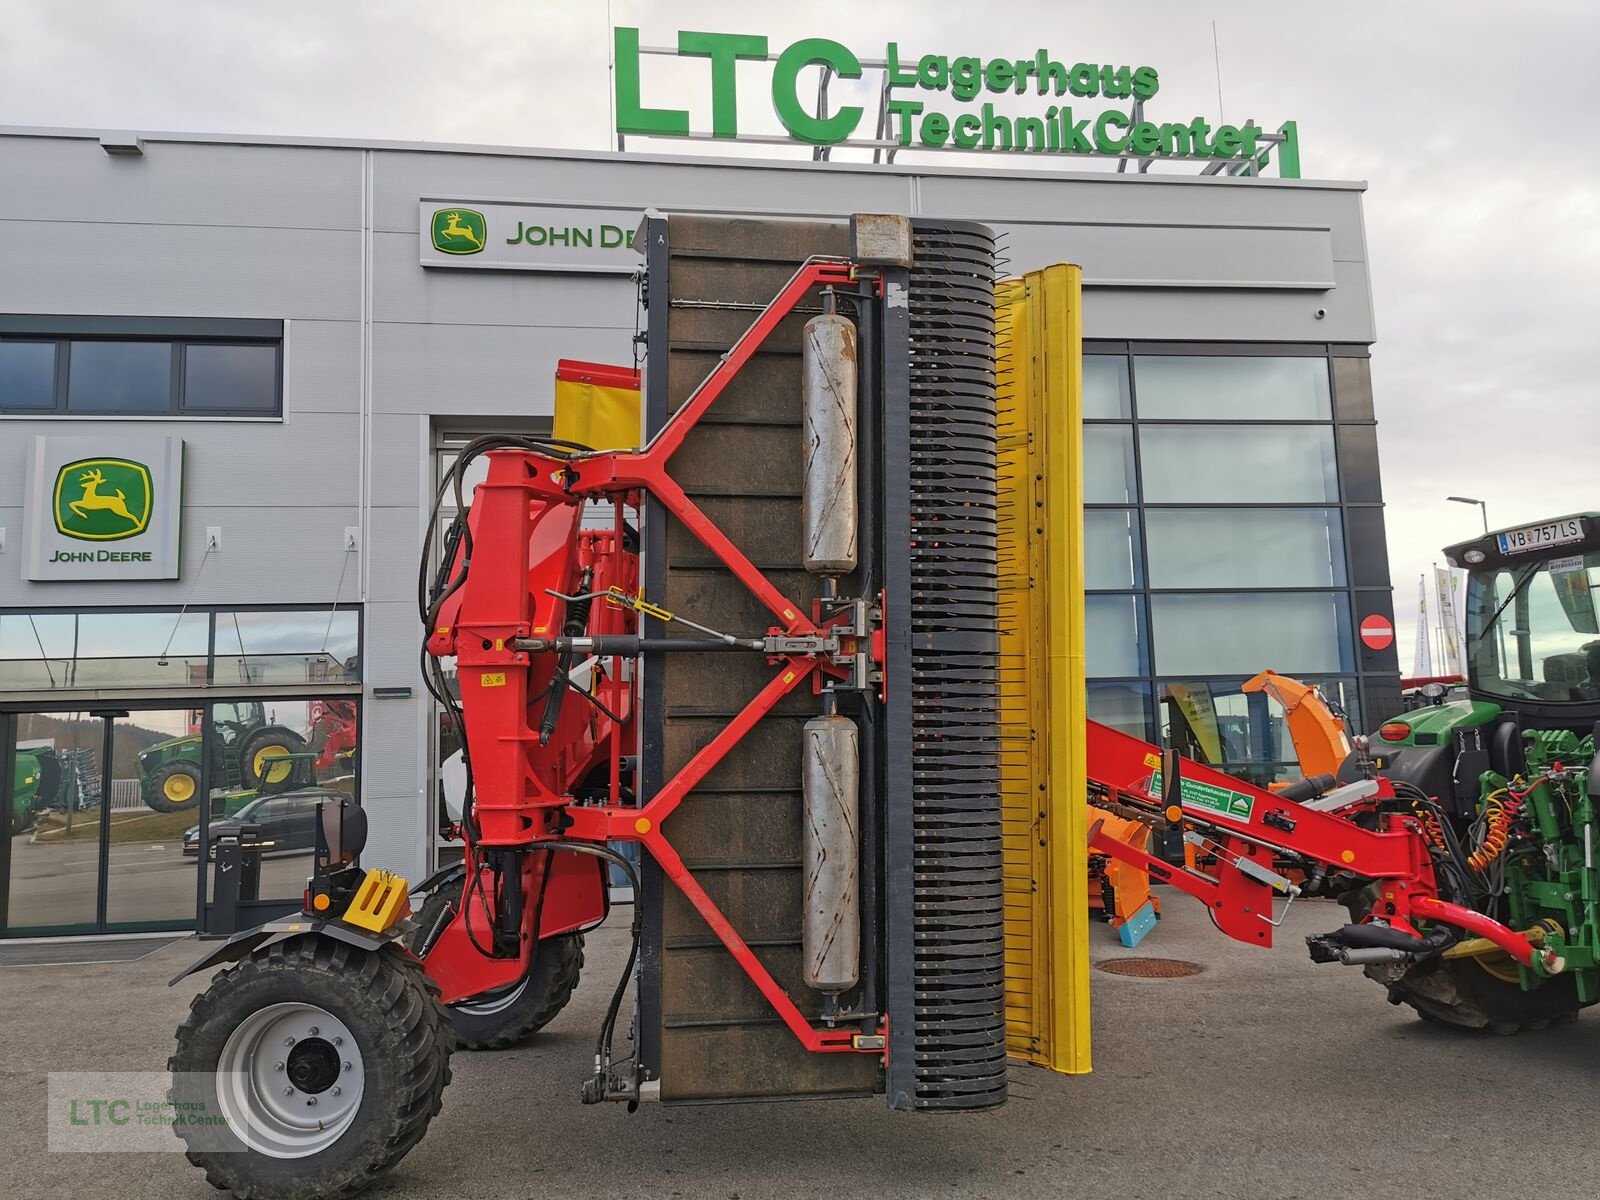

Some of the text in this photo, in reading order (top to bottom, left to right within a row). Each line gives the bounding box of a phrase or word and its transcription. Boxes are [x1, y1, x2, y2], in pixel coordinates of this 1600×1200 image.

[614, 26, 864, 145] LTC
[887, 42, 1160, 102] Lagerhaus
[887, 100, 1263, 159] TechnikCenter
[506, 221, 636, 249] JOHN DE
[1509, 521, 1577, 547] VB 757 LS
[49, 550, 152, 562] JOHN DEERE
